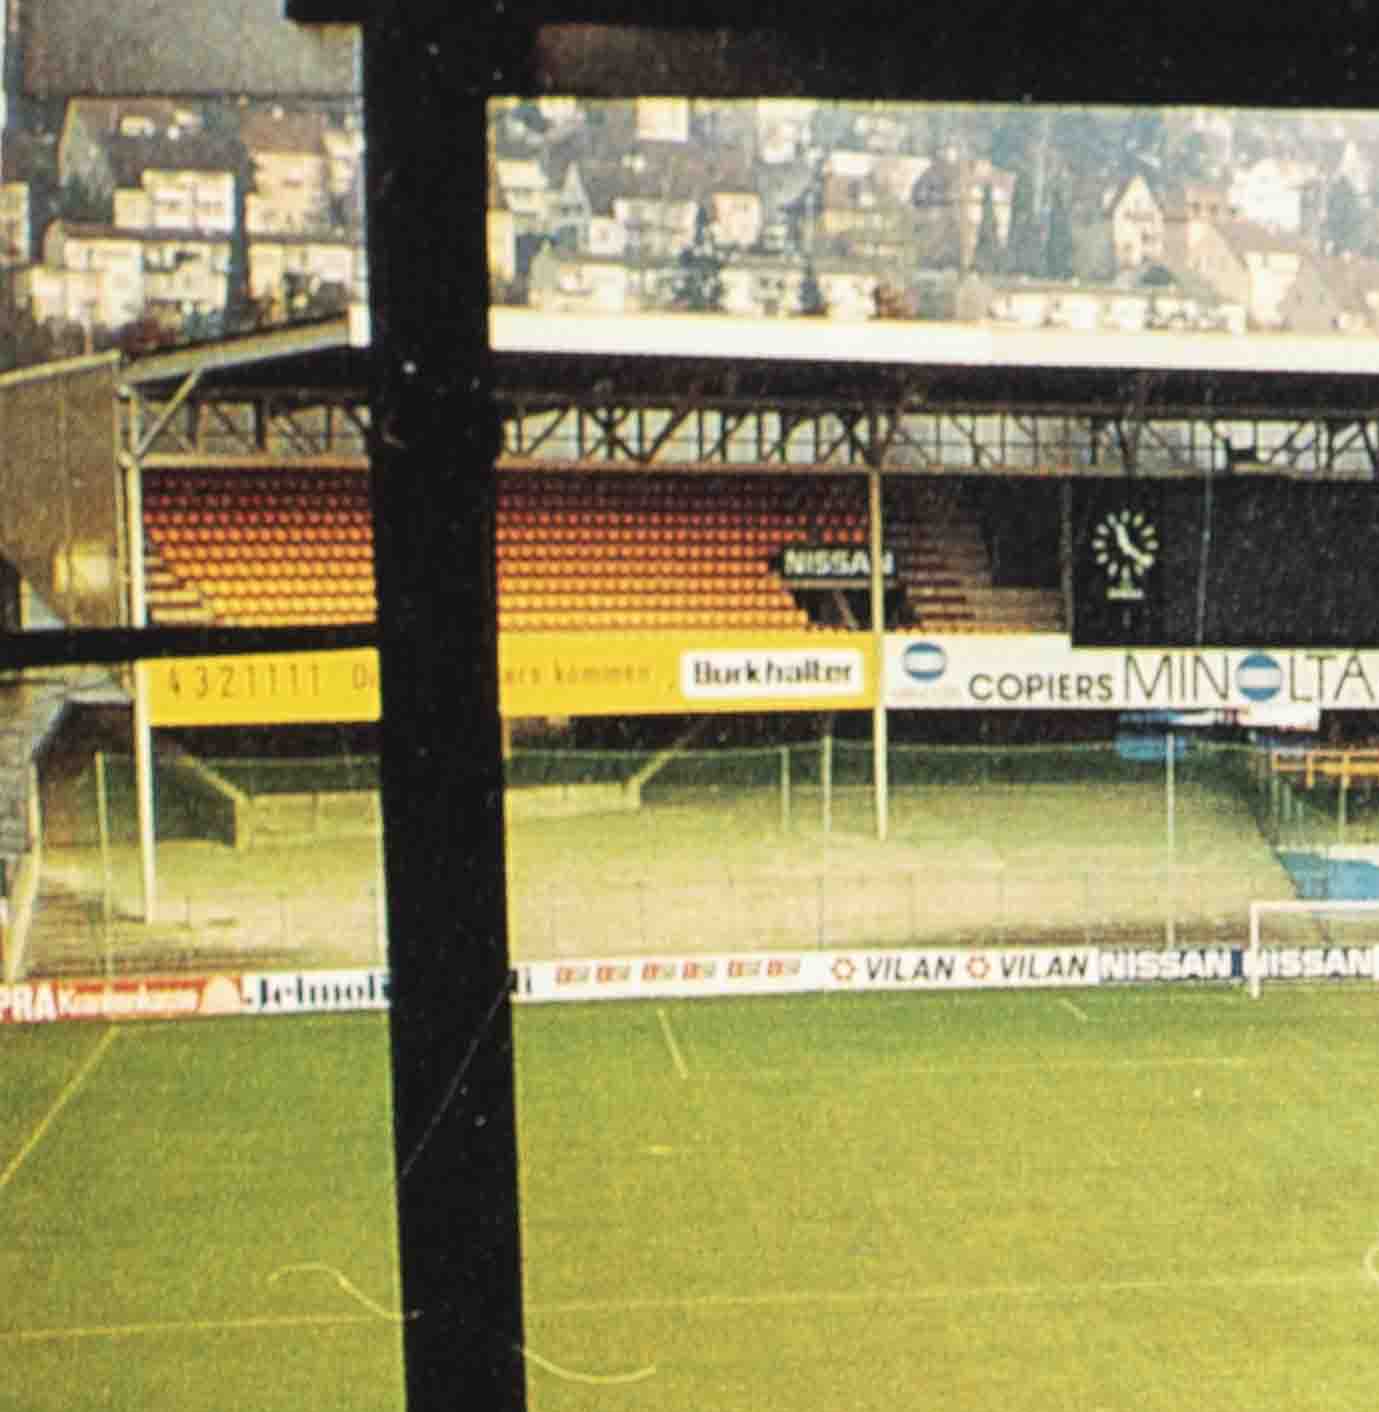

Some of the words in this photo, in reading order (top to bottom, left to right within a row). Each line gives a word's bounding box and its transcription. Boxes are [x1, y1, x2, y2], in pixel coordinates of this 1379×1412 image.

[784, 549, 895, 576] NISSAN
[693, 657, 855, 690] Burkhalter
[967, 673, 1114, 702] COPIERS
[866, 955, 955, 981] VILAN
[1001, 954, 1089, 977] VILAN
[1101, 949, 1231, 979] NISSAN
